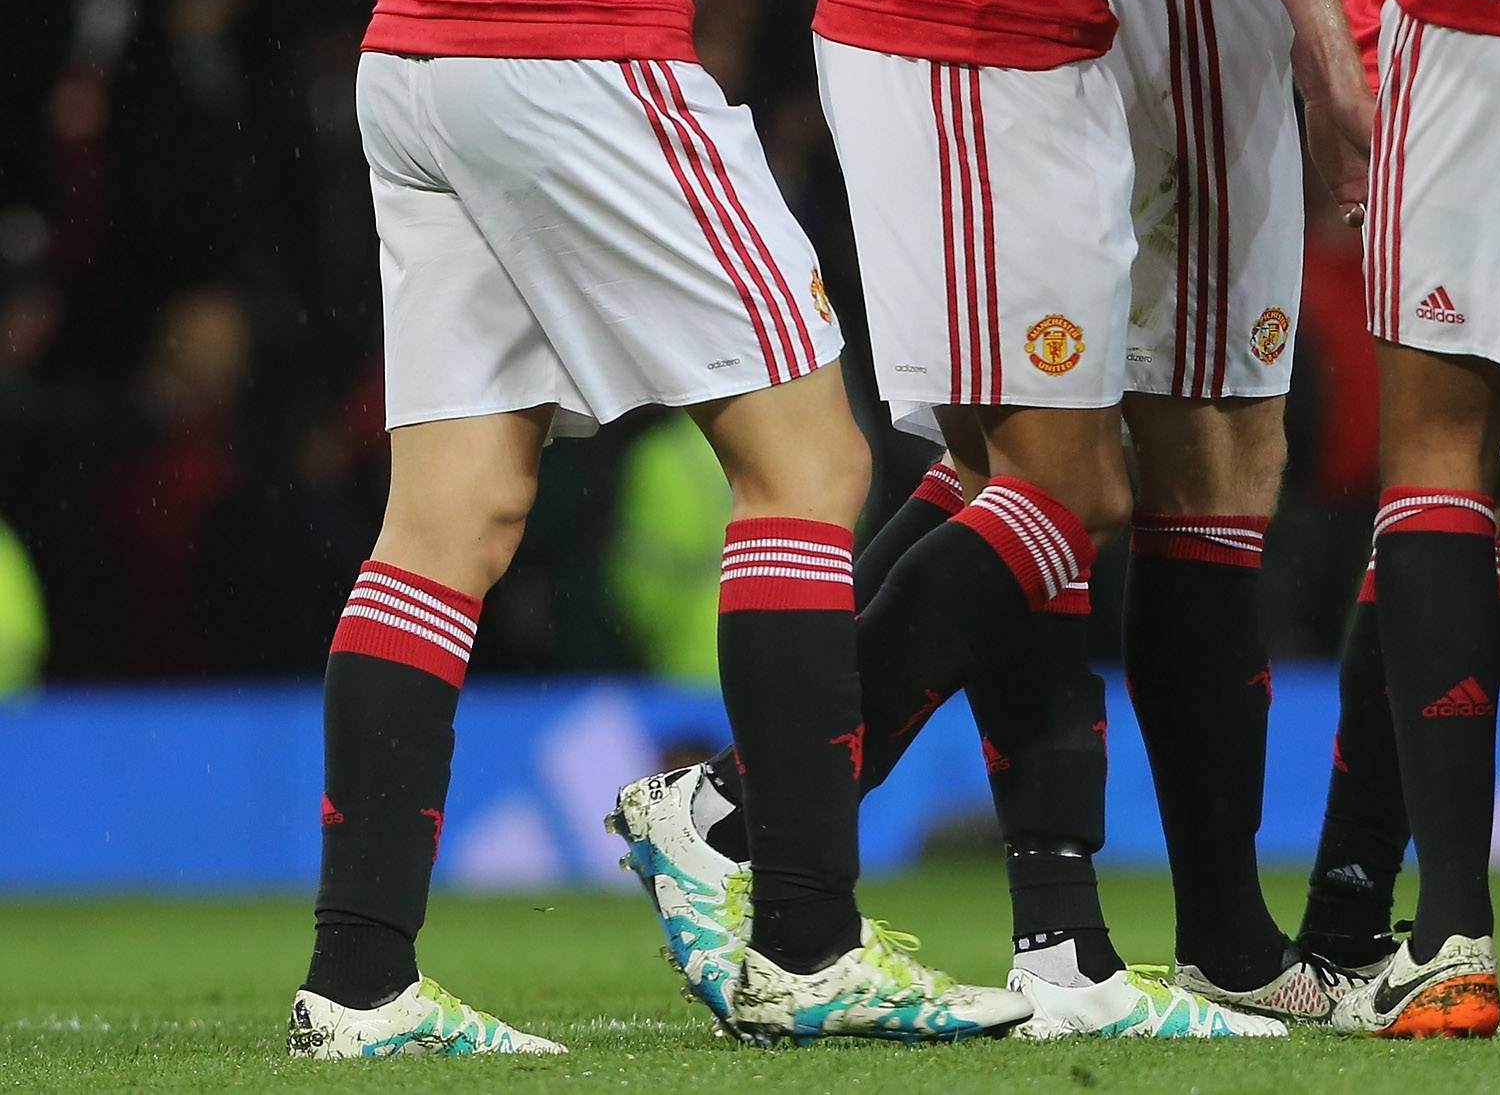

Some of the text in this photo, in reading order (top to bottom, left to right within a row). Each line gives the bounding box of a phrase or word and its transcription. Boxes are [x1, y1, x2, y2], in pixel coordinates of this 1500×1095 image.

[1415, 306, 1466, 324] adidas
[706, 357, 741, 370] adizero
[1422, 699, 1495, 718] adidas
